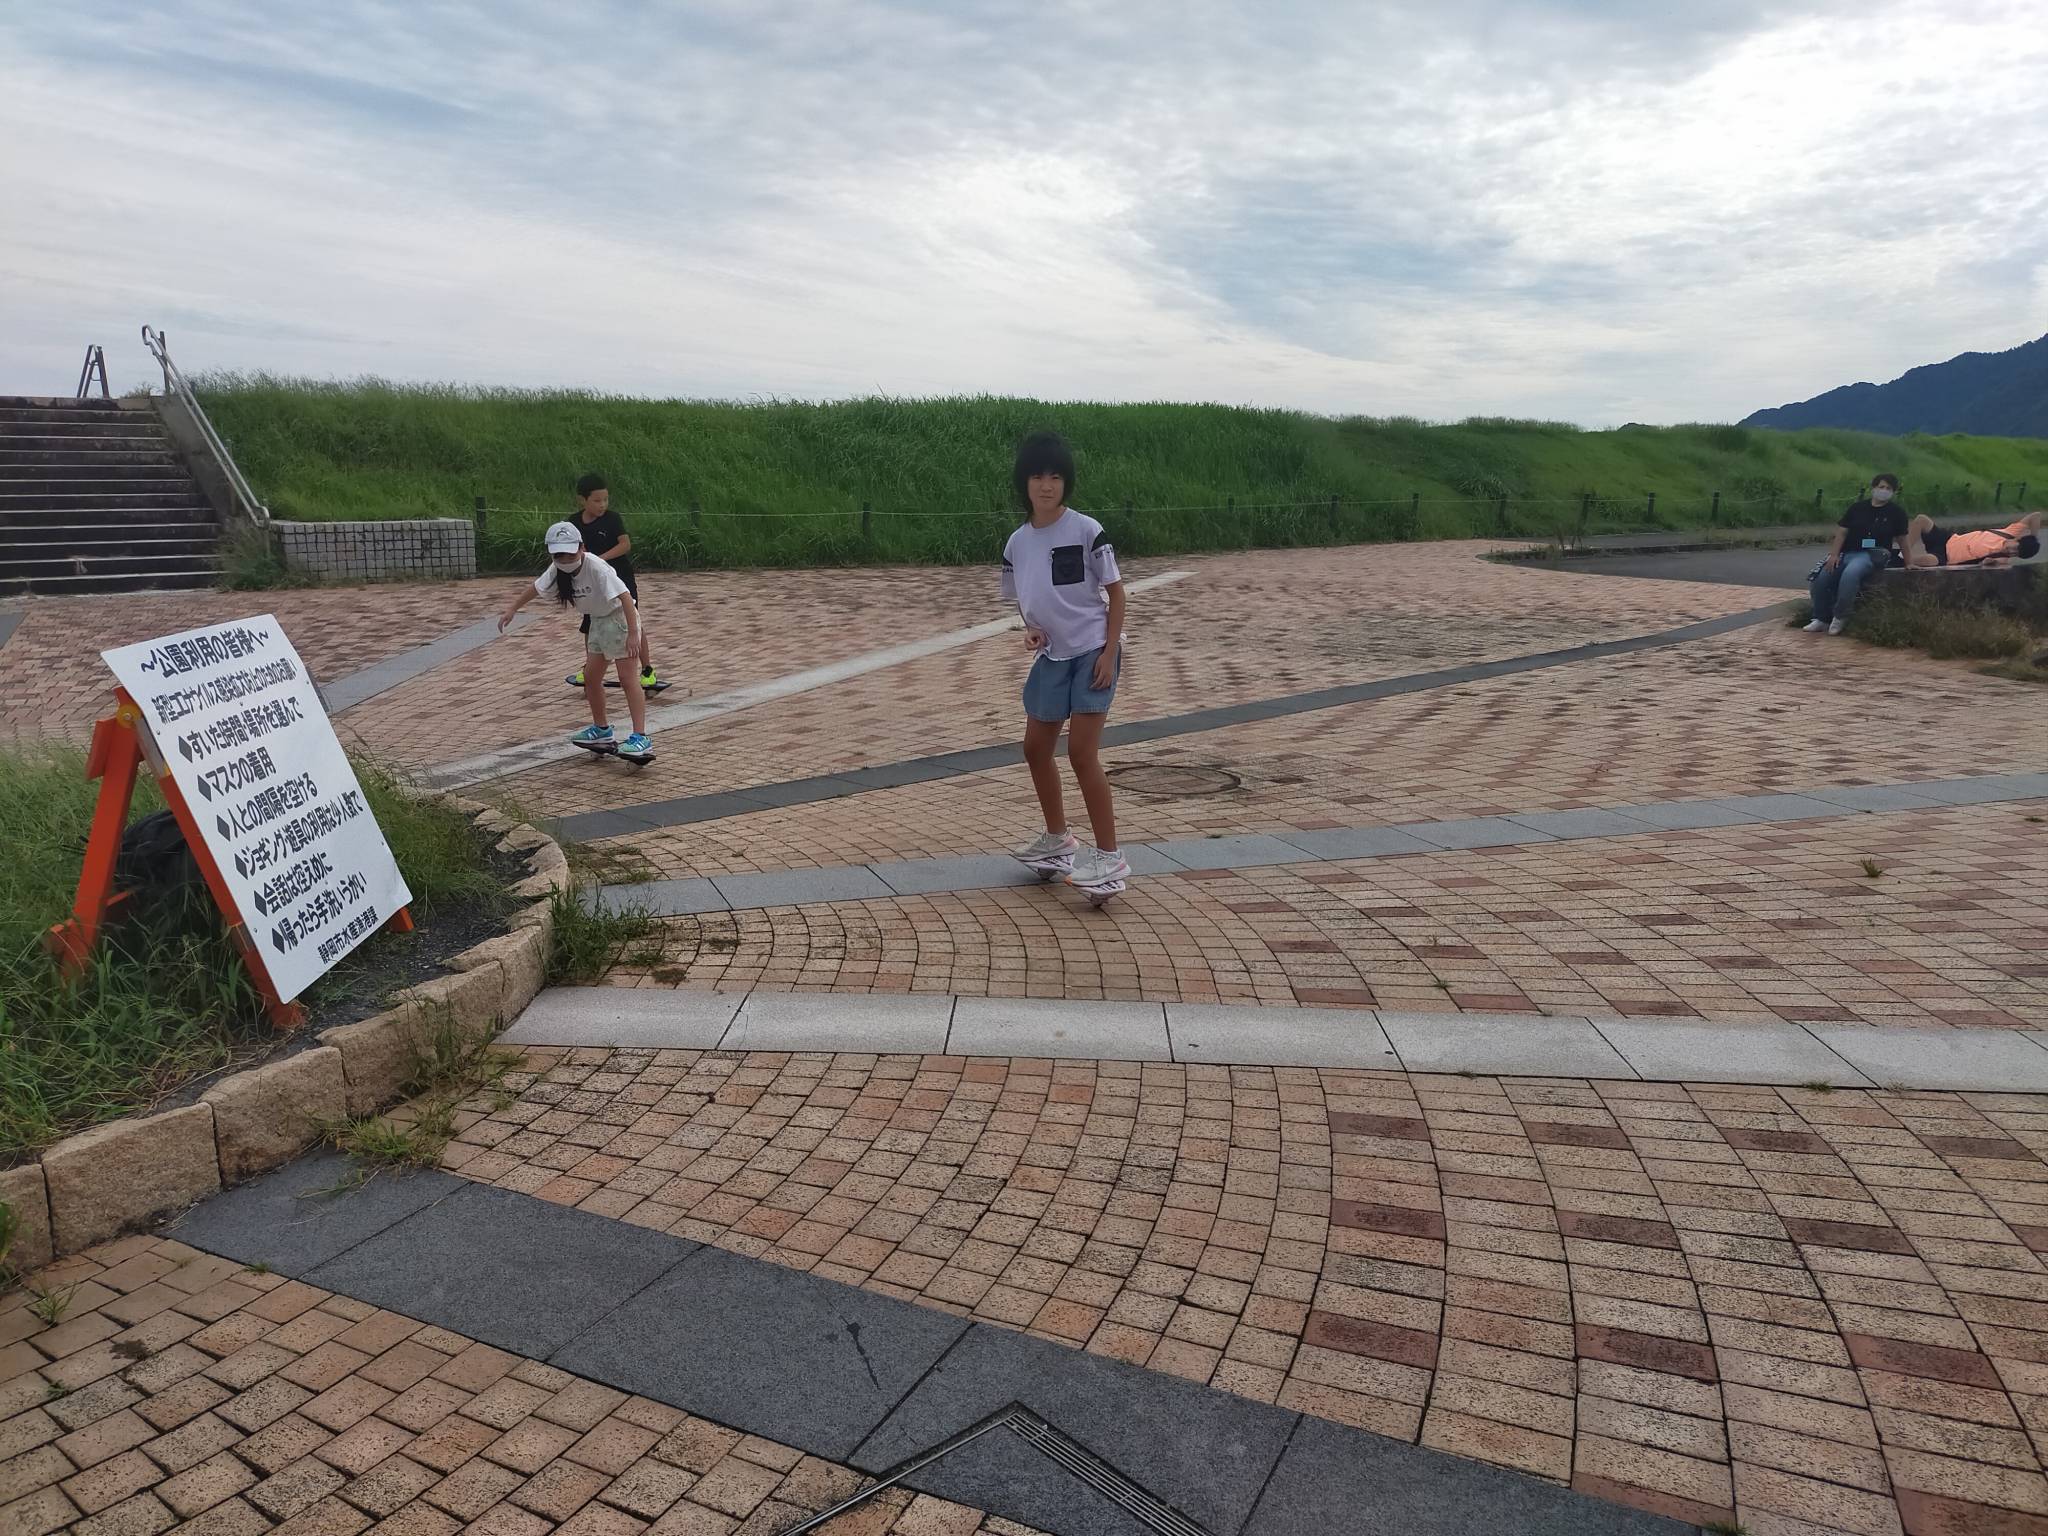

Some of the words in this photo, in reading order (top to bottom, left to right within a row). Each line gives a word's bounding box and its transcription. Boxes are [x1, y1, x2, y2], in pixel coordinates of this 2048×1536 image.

[206, 746, 276, 797] マスクの着用
[227, 773, 317, 838] 人との間隔を空ける
[264, 852, 333, 914] 会話は控えめに
